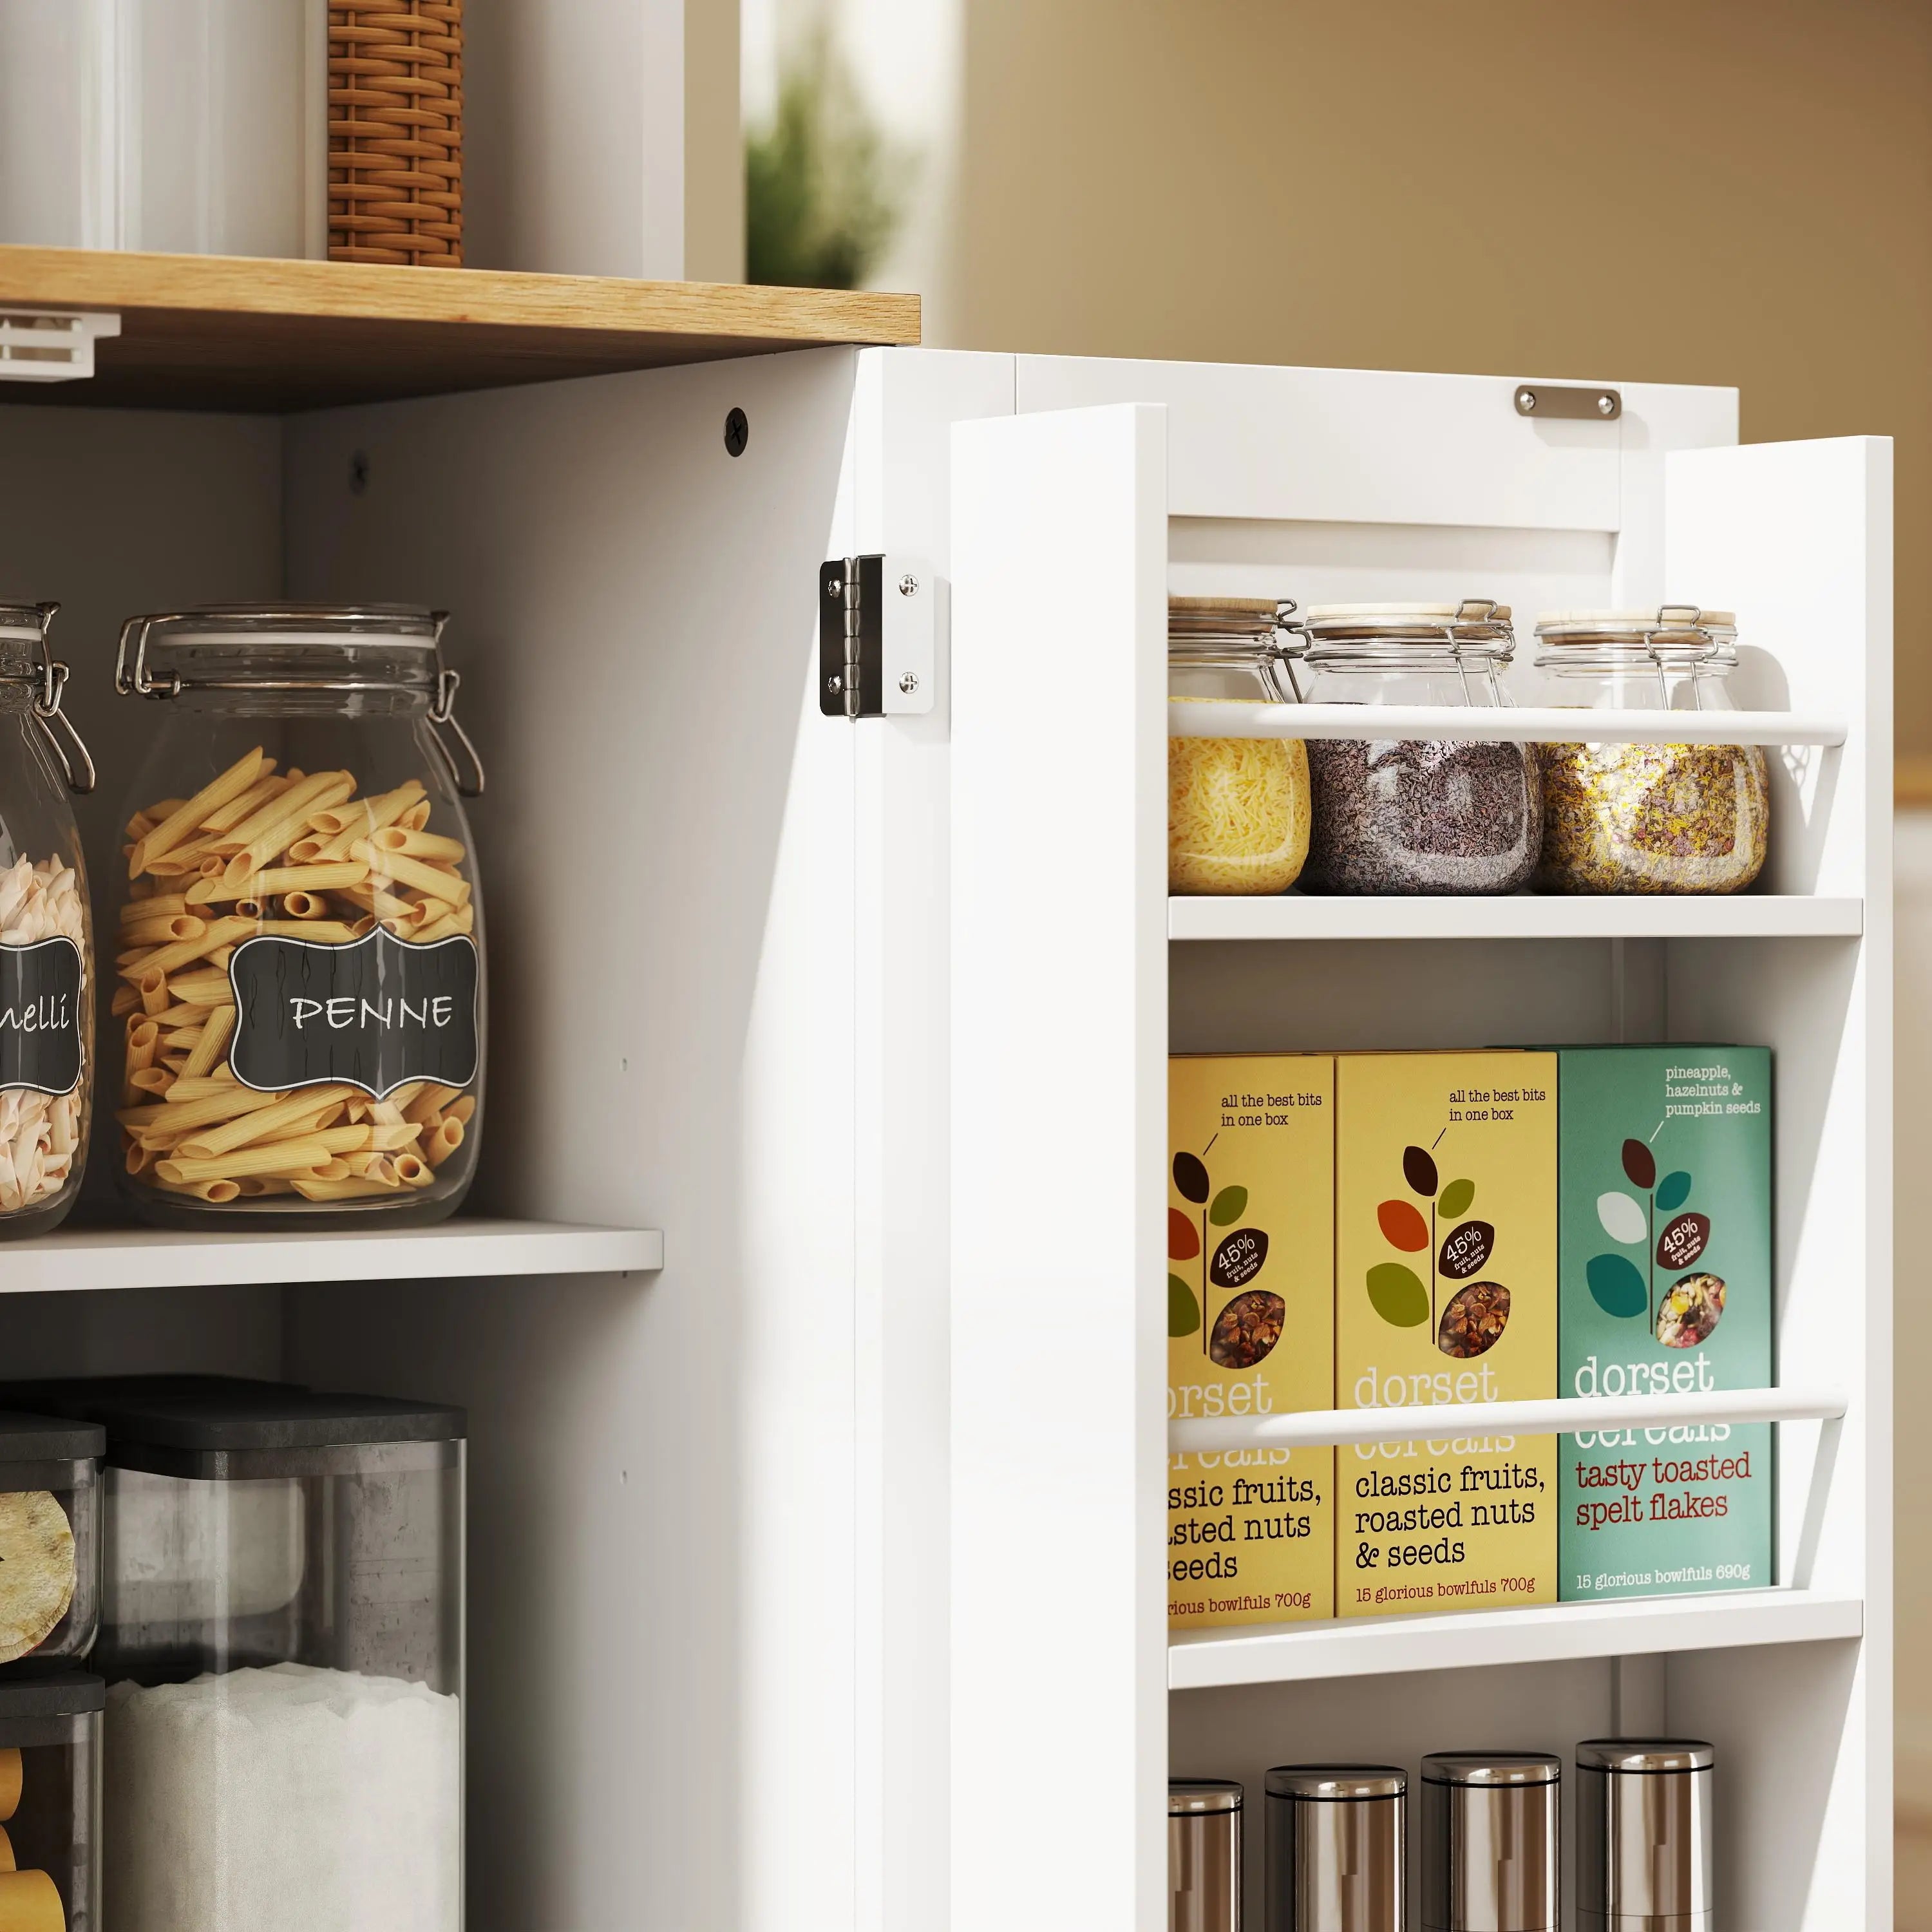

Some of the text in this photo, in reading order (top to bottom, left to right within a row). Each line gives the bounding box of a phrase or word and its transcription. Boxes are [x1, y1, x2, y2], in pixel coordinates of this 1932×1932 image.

[290, 996, 452, 1029] PENNE
[1665, 1065, 1731, 1081] pineapple,
[1222, 1093, 1321, 1107] all the best bits
[1450, 1088, 1546, 1103] all the best bits
[1665, 1083, 1743, 1097] hazelnuts &
[1222, 1113, 1288, 1126] in one box
[1450, 1108, 1513, 1121] in one box
[1665, 1101, 1761, 1117] pumpkin seeds
[1447, 1226, 1481, 1261] 45%
[1664, 1218, 1698, 1253] 45%
[1218, 1234, 1255, 1270] 45%
[1243, 1252, 1258, 1266] nuts
[1468, 1253, 1484, 1269] seeds
[1470, 1244, 1484, 1258] nuts
[1240, 1262, 1258, 1278] seeds
[1355, 1363, 1498, 1408] dorset
[1575, 1352, 1714, 1397] dorset
[1356, 1463, 1544, 1497] classic fruits,
[1575, 1452, 1752, 1490] tasty toasted
[1232, 1475, 1320, 1506] fruits,
[1355, 1499, 1535, 1533] roasted nuts
[1577, 1492, 1728, 1530] spelt flakes
[1168, 1512, 1311, 1545] sted nuts
[1356, 1537, 1465, 1568] & seeds
[1168, 1552, 1237, 1581] eeds
[1577, 1564, 1750, 1590] 15 glorious bowlfuls 690g
[1208, 1595, 1271, 1613] bowlfuls
[1274, 1593, 1311, 1609] 700g
[1356, 1577, 1535, 1603] 15 glorious bowlfuls 700g
